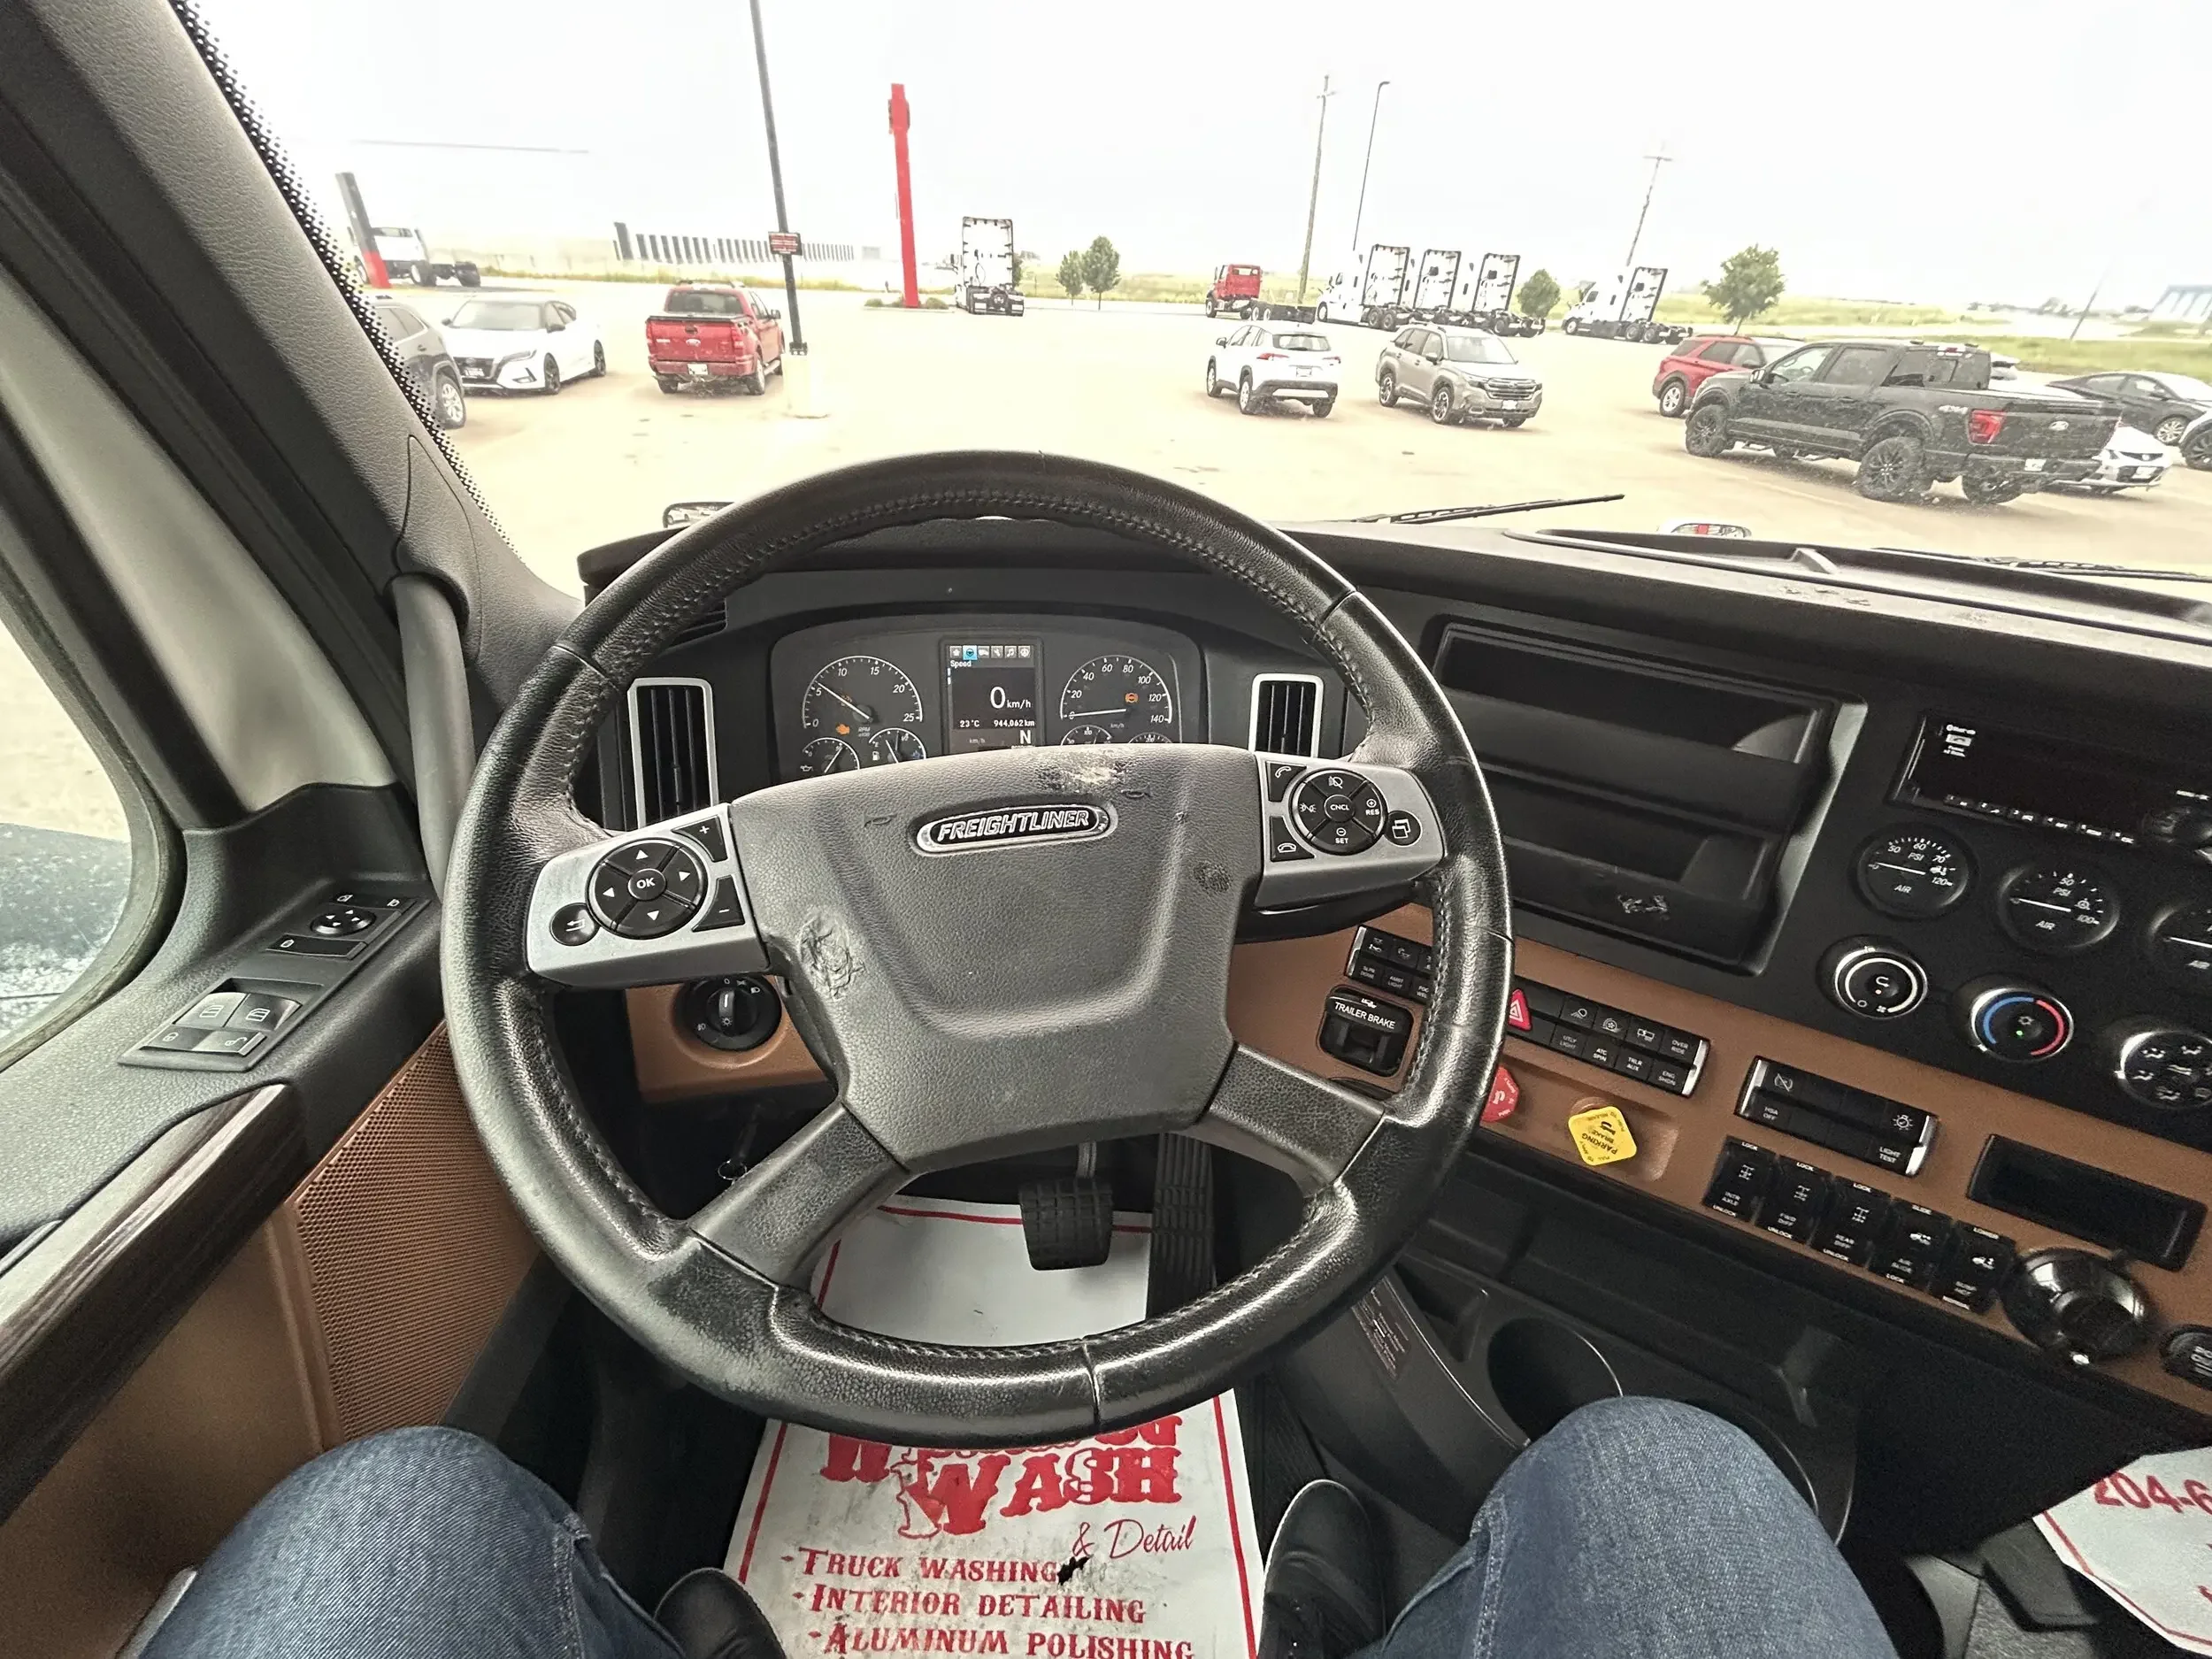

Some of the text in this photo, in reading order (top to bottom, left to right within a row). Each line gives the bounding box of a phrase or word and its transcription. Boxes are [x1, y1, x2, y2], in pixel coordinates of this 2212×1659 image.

[950, 660, 972, 669] Speed
[1122, 664, 1133, 673] 80
[870, 666, 879, 675] 15
[990, 686, 1032, 710] 0 km/h
[903, 713, 914, 722] 25
[1019, 730, 1032, 744] N
[938, 810, 1090, 841] FREIGHTLINER
[1908, 852, 1924, 861] PSI
[636, 878, 656, 889] OK
[1932, 877, 1947, 886] 120
[2059, 877, 2075, 886] 50
[1894, 885, 1912, 894] AIR
[2053, 887, 2071, 896] PSI
[2077, 914, 2095, 924] 100
[2035, 920, 2055, 931] AIR
[1335, 1002, 1395, 1030] TRAILER BRAKE
[1559, 1041, 1576, 1049] LIGHT
[1671, 1040, 1689, 1049] OVER
[1671, 1046, 1686, 1055] RIDE
[1593, 1053, 1607, 1062] SPIN
[1628, 1056, 1643, 1066] TRLR
[1662, 1070, 1675, 1079] ENG
[1592, 1130, 1614, 1144] BRAKE
[1582, 1133, 1618, 1155] PARKING
[1741, 1141, 1758, 1151] LOCK
[1879, 1146, 1901, 1157] LIGHT
[1879, 1153, 1897, 1164] TEST
[1796, 1162, 1814, 1171] LOCK
[1853, 1182, 1871, 1193] LOCK
[1713, 1204, 1737, 1217] UNLOCK
[1768, 1226, 1793, 1239] UNLOCK
[1823, 1248, 1850, 1263] UNLOCK
[1886, 1273, 1905, 1284] LOCK
[919, 1447, 1183, 1534] WASH
[1072, 1515, 1197, 1559] & Detail
[798, 1547, 1058, 1583] TRUCK WASHING
[810, 1583, 1147, 1624] INTERIOR DETAILING
[824, 1623, 1194, 1659] ALUMINUM POLISHING
